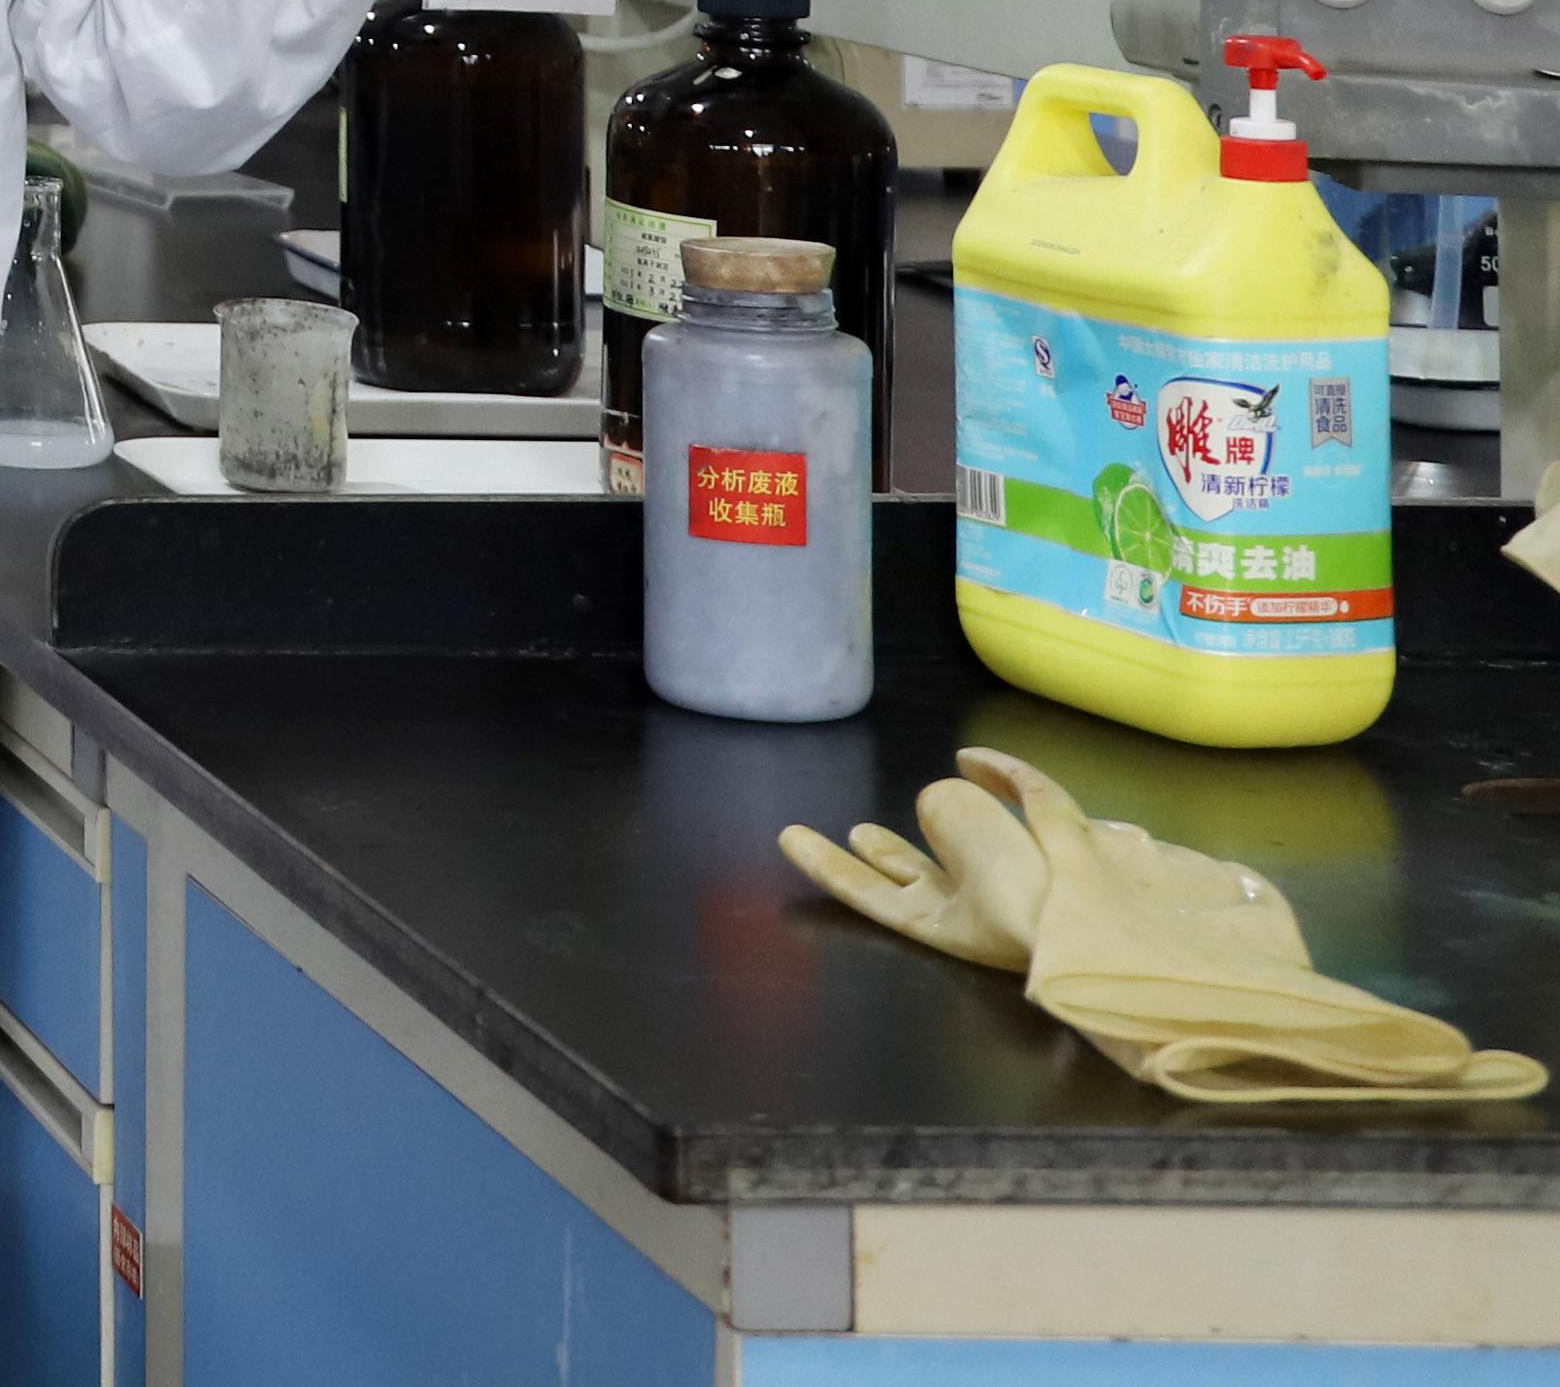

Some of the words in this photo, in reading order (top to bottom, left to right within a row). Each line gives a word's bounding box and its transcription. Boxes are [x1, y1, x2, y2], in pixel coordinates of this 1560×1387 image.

[697, 465, 800, 496] 分析废液
[1201, 473, 1290, 497] 清新柠檬
[708, 498, 786, 527] 收集瓶
[1187, 591, 1248, 617] 不伤手
